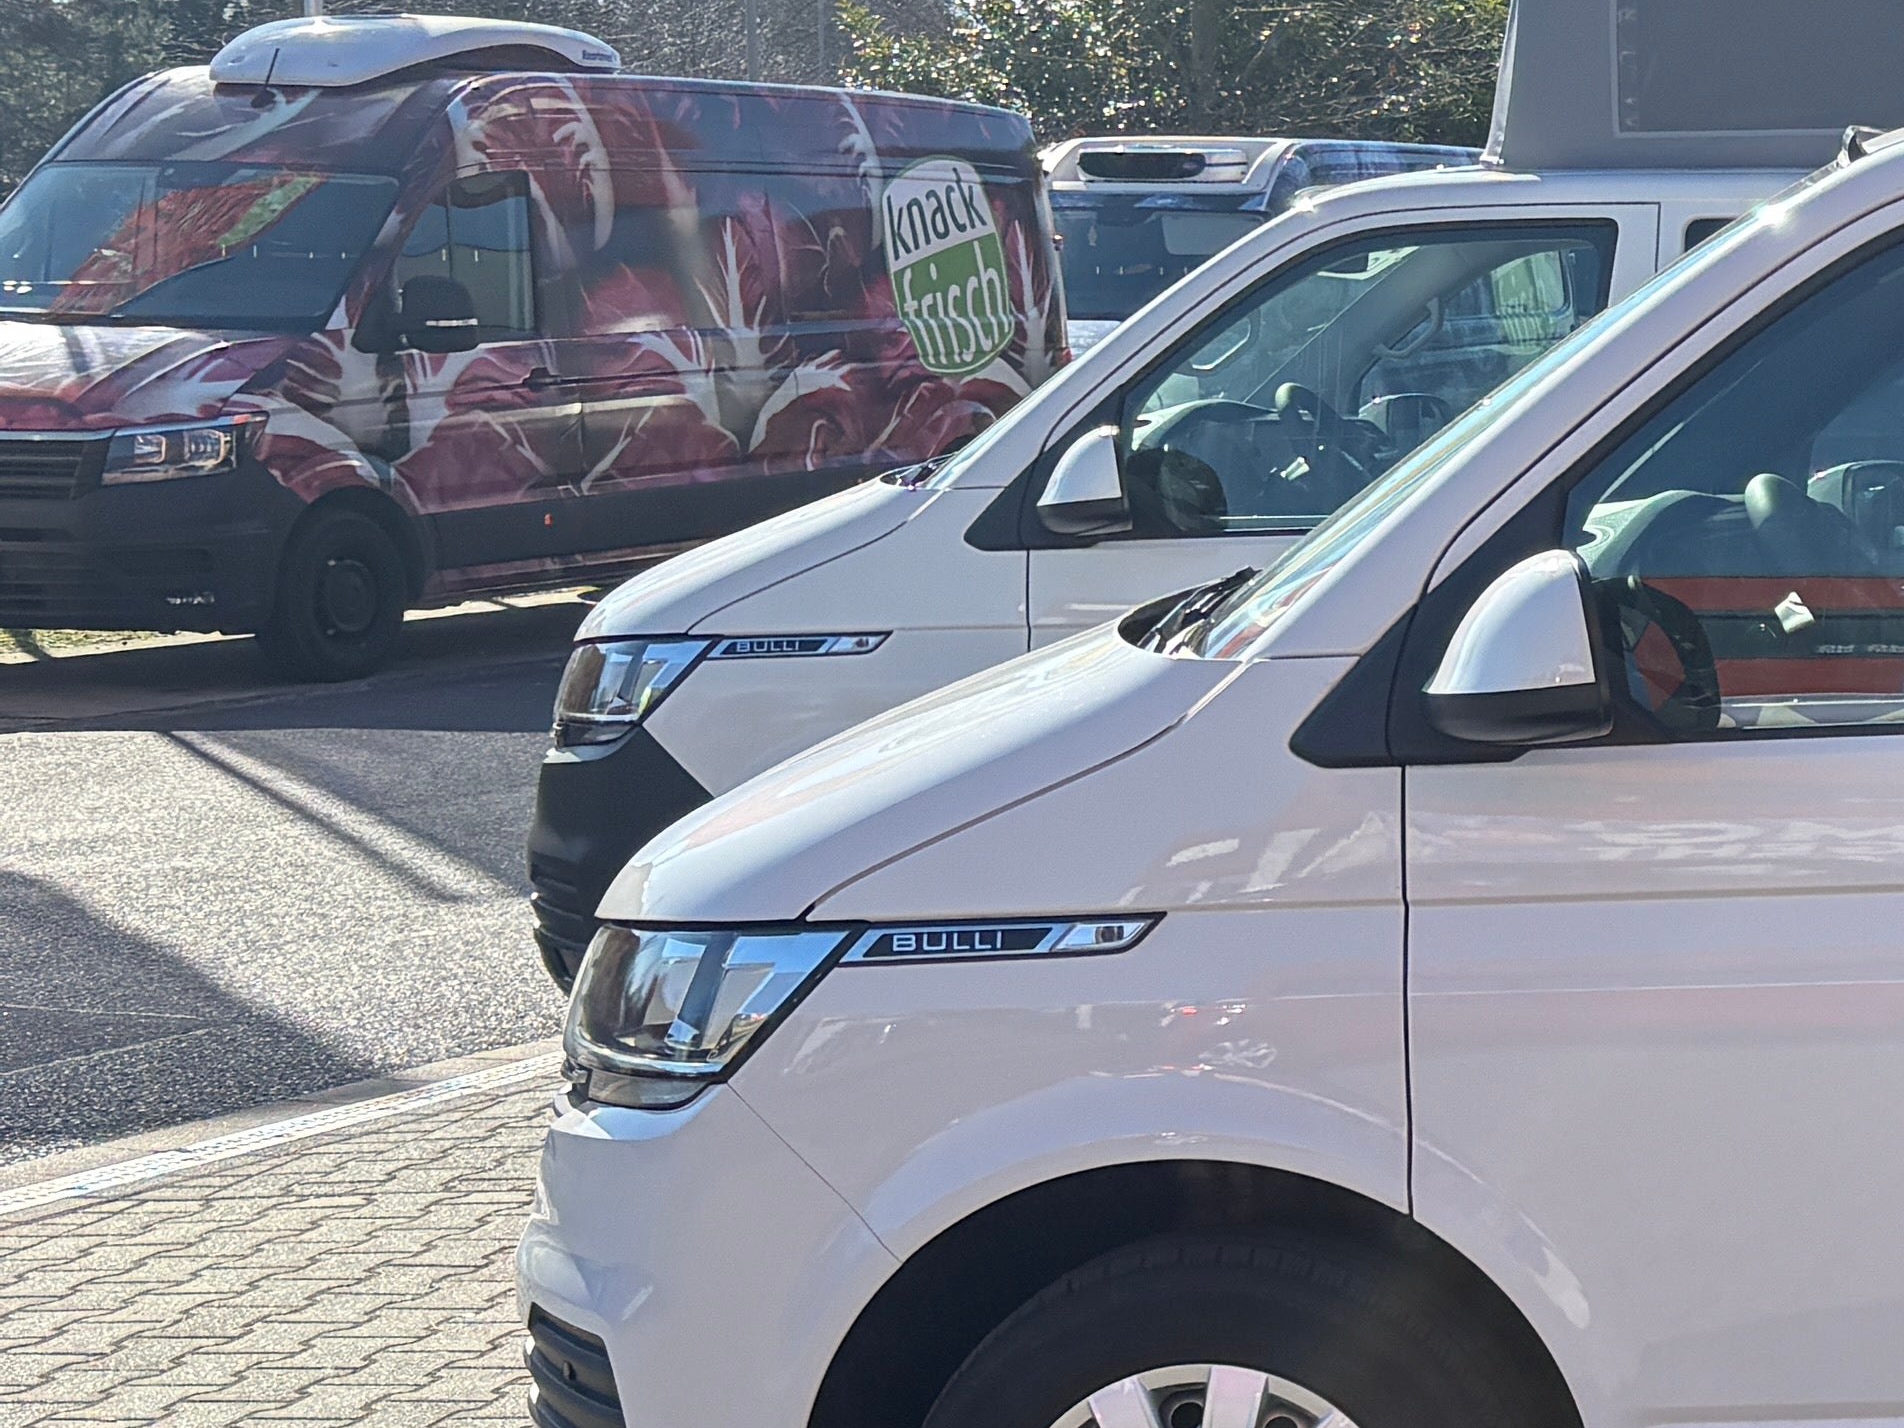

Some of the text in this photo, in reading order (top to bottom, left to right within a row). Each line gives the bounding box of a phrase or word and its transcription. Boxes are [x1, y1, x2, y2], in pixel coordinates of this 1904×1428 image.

[886, 166, 988, 262] knack
[903, 239, 1010, 365] frisch
[736, 639, 800, 653] BULLI
[892, 930, 1002, 952] BULLI
